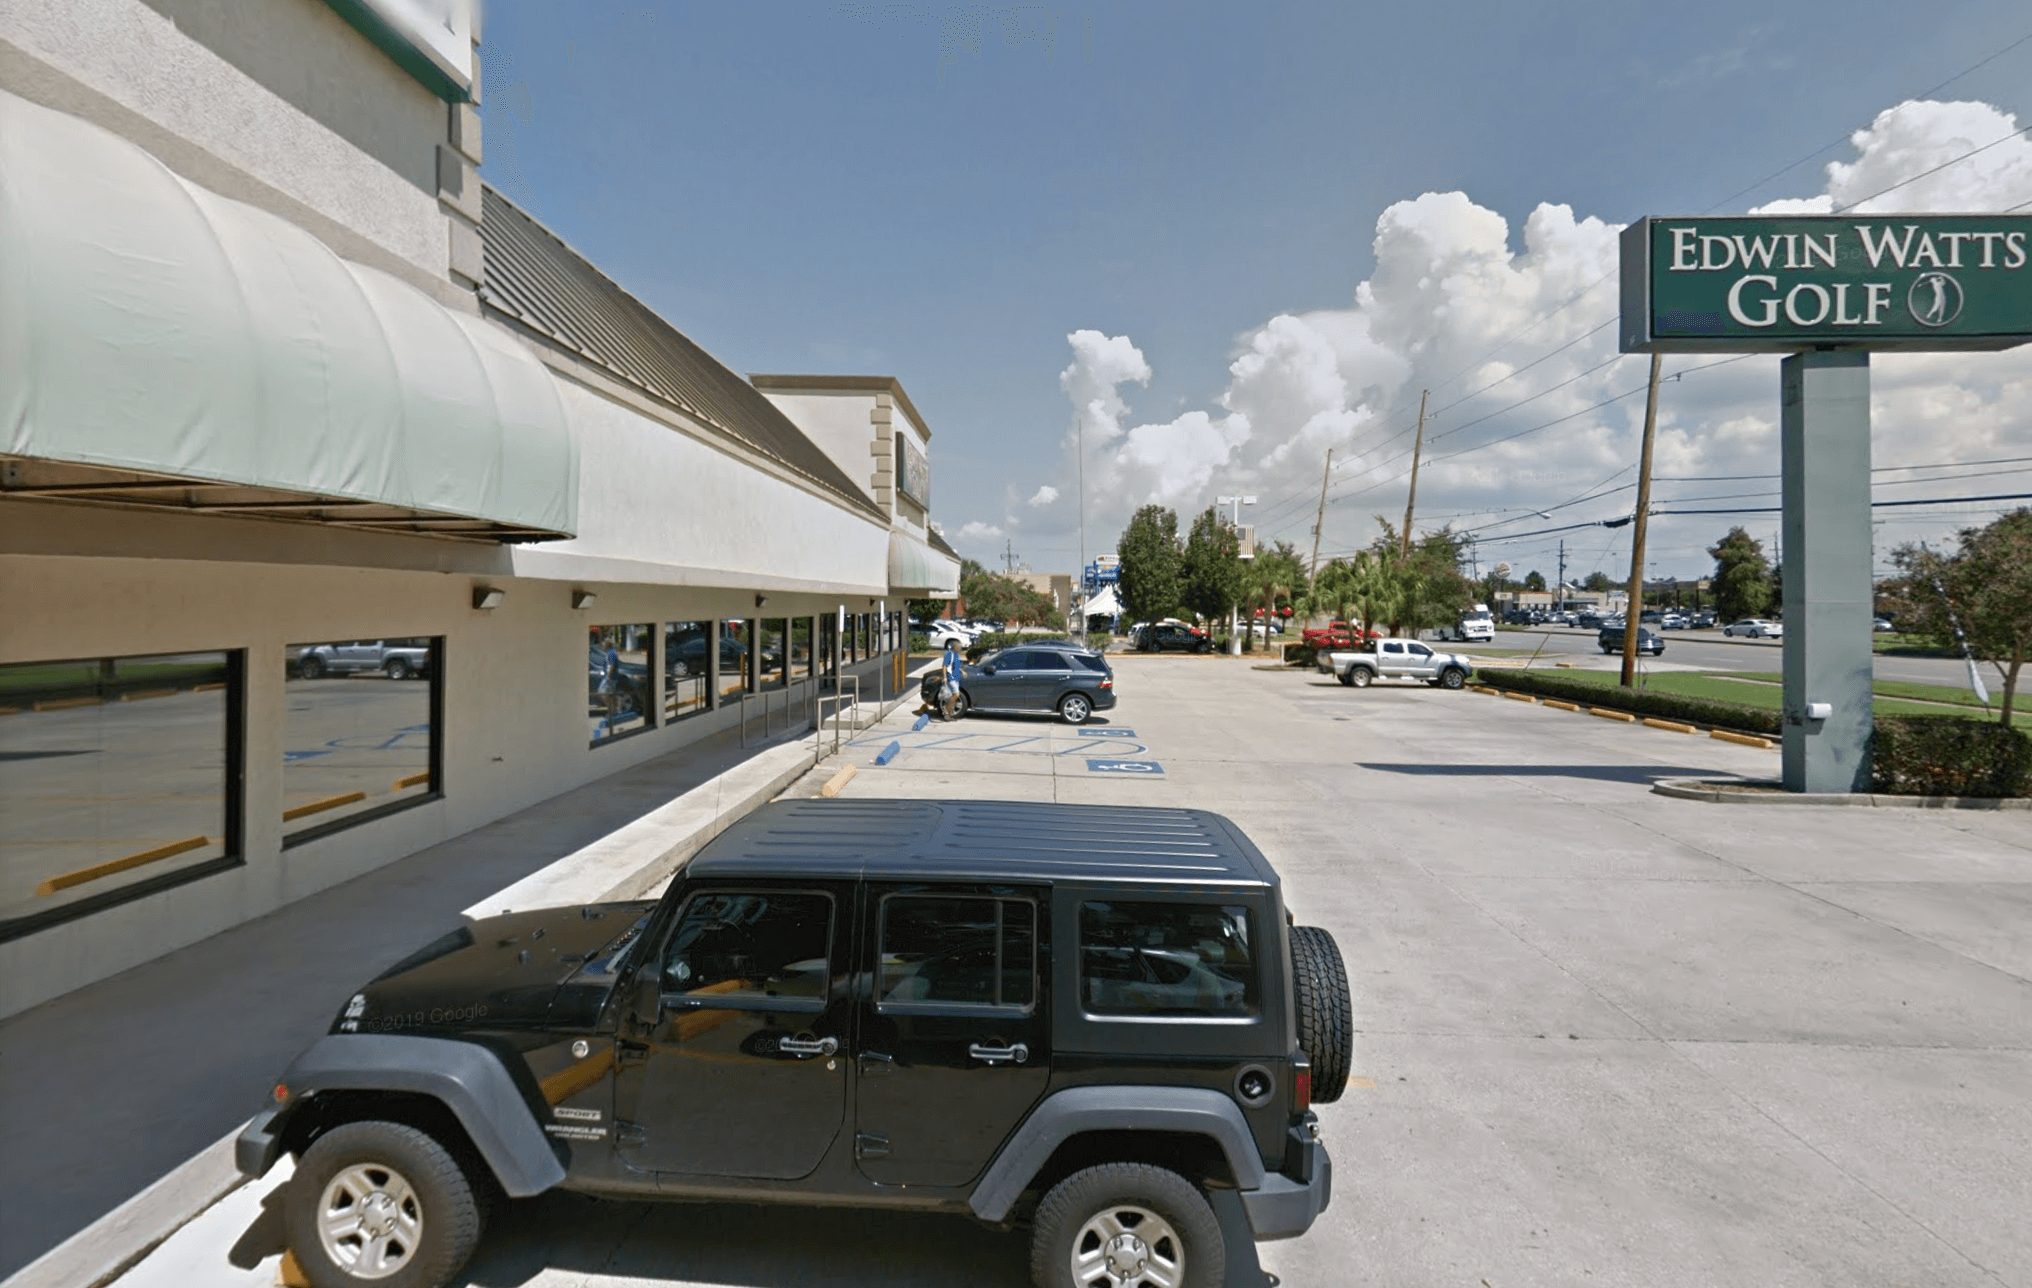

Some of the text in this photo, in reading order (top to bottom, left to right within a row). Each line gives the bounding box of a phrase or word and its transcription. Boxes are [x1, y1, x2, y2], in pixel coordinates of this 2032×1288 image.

[1668, 227, 1839, 272] EDWIN
[1854, 225, 2027, 269] WATTS
[1726, 274, 1892, 327] GOLF
[557, 1109, 599, 1118] SPORT
